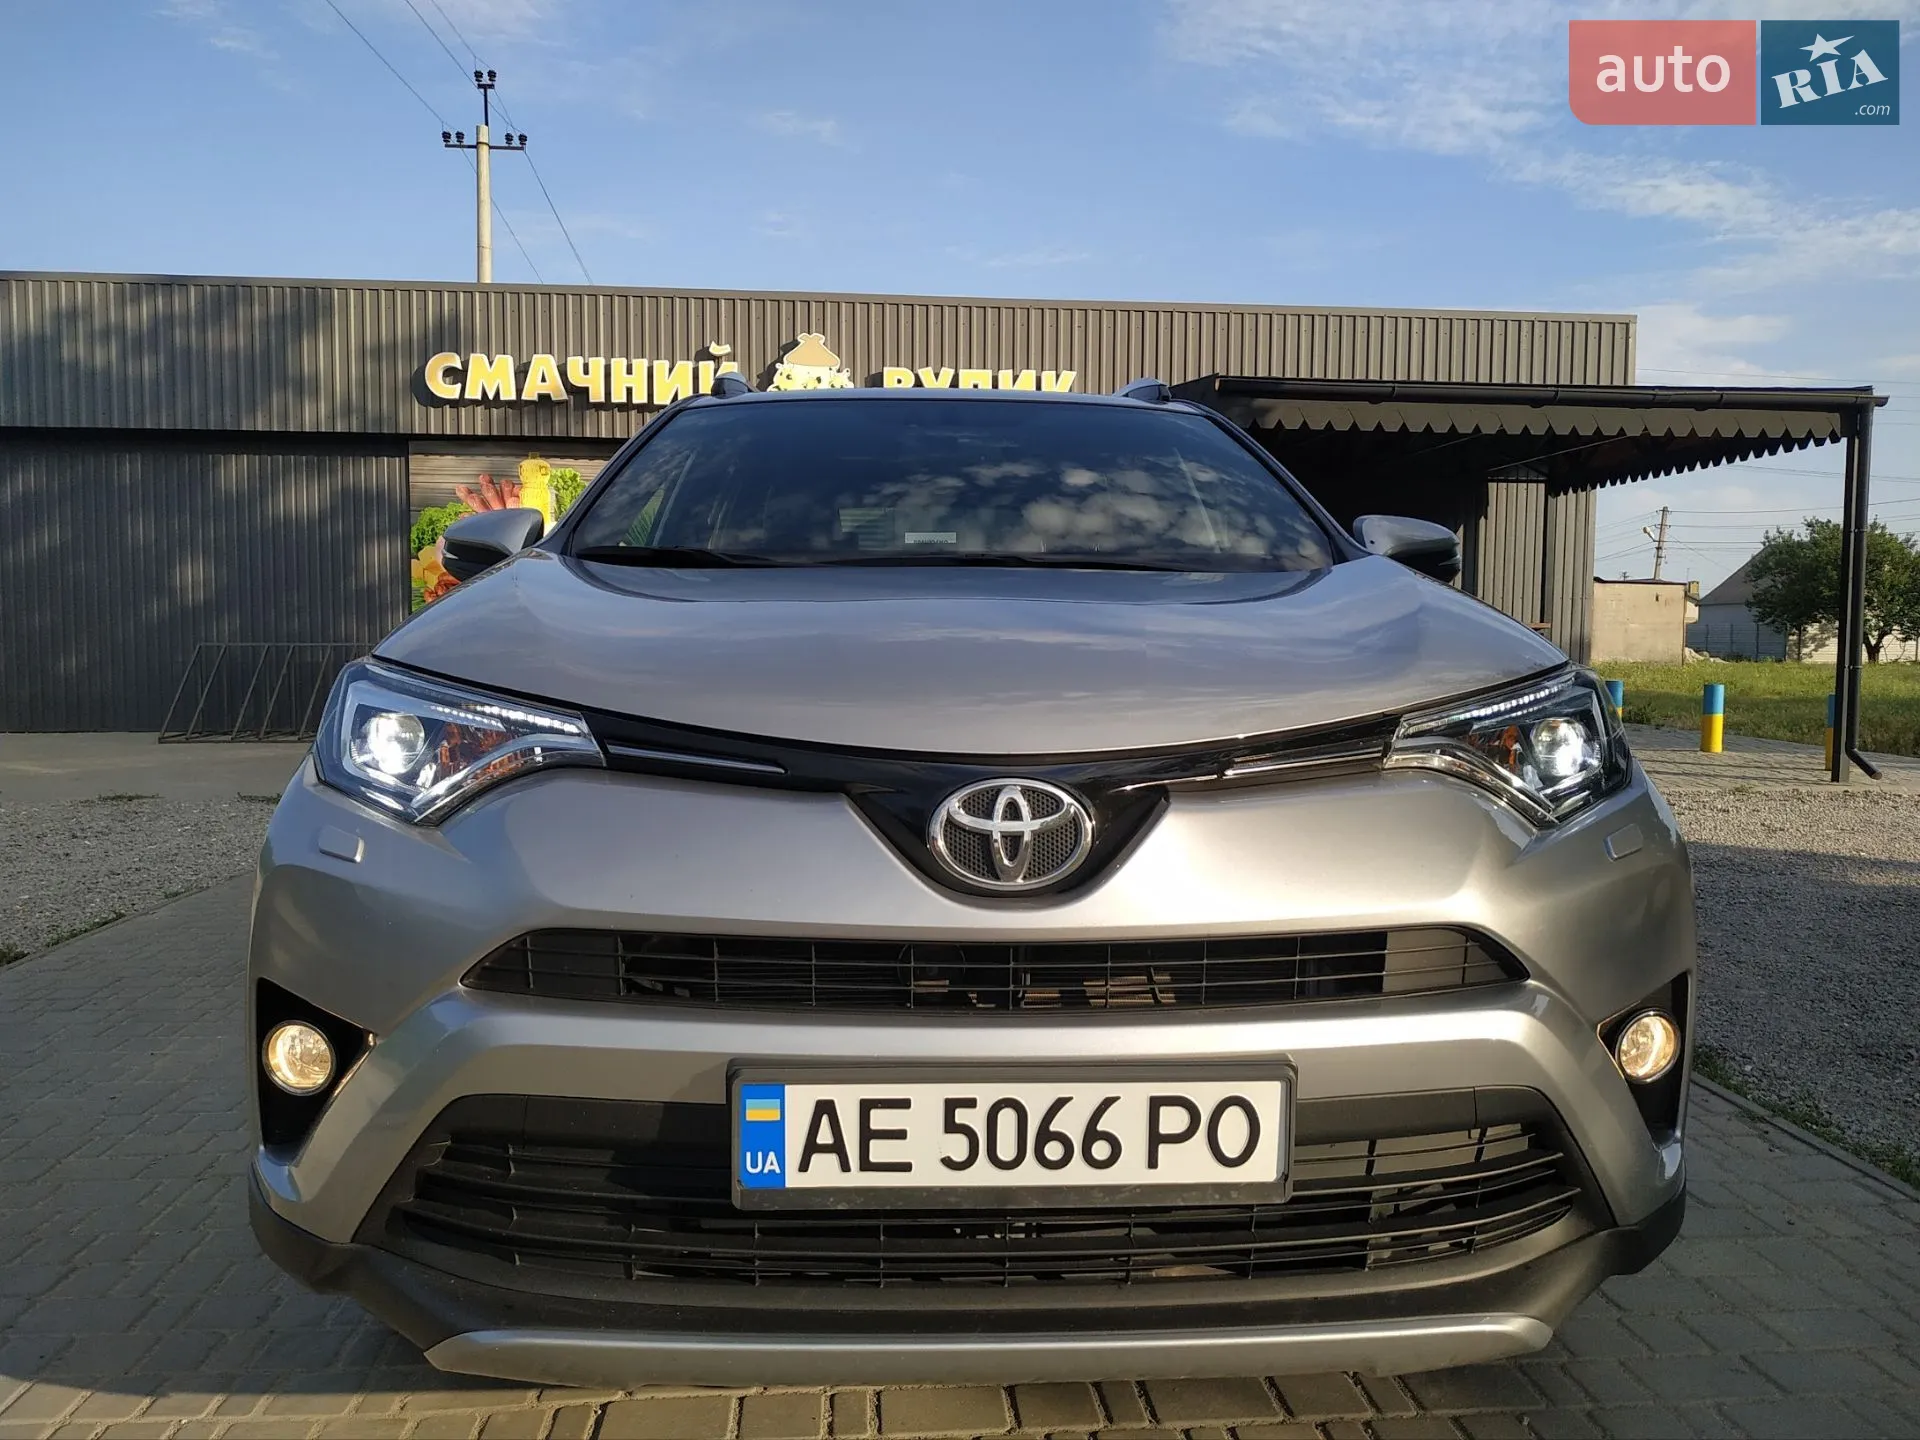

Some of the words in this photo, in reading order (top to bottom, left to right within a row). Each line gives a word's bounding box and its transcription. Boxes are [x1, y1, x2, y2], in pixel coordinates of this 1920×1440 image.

[425, 341, 738, 405] СМАЧНИЙ
[745, 1151, 781, 1174] UA
[797, 1098, 913, 1174] AE
[939, 1096, 1123, 1172] 5066
[1147, 1095, 1261, 1169] PO
